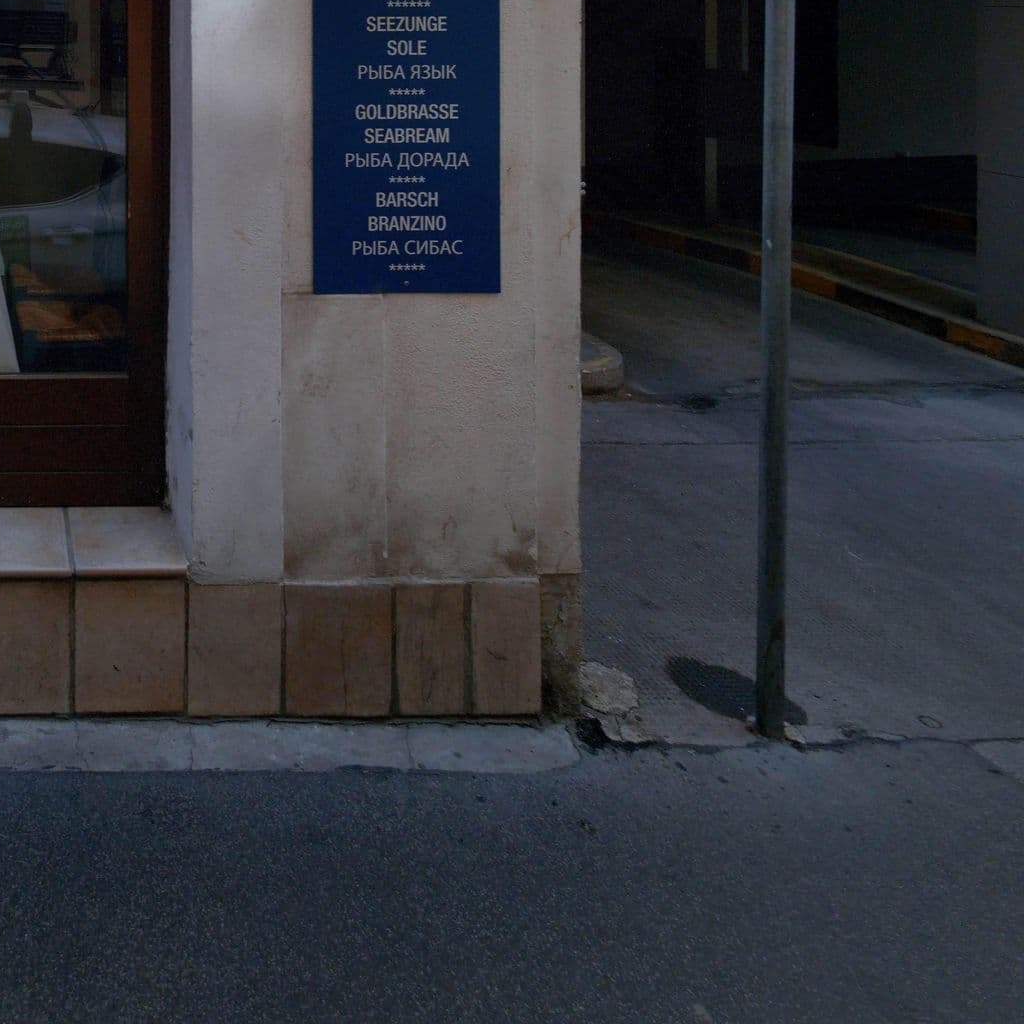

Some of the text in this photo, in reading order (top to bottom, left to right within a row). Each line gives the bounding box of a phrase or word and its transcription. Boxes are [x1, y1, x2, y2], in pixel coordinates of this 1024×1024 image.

[367, 16, 447, 31] SEEZUNGE
[388, 40, 426, 55] SOLE
[358, 65, 456, 79] РЫБА ЯЗЫК
[356, 104, 458, 120] GOLDBRASSE
[365, 128, 449, 143] SEABREAM
[346, 152, 469, 170] РЫБА ДОРАДА
[376, 192, 438, 207] BARSCH
[368, 216, 446, 231] BRANZINO
[353, 240, 463, 255] РЫБА СИБАС
